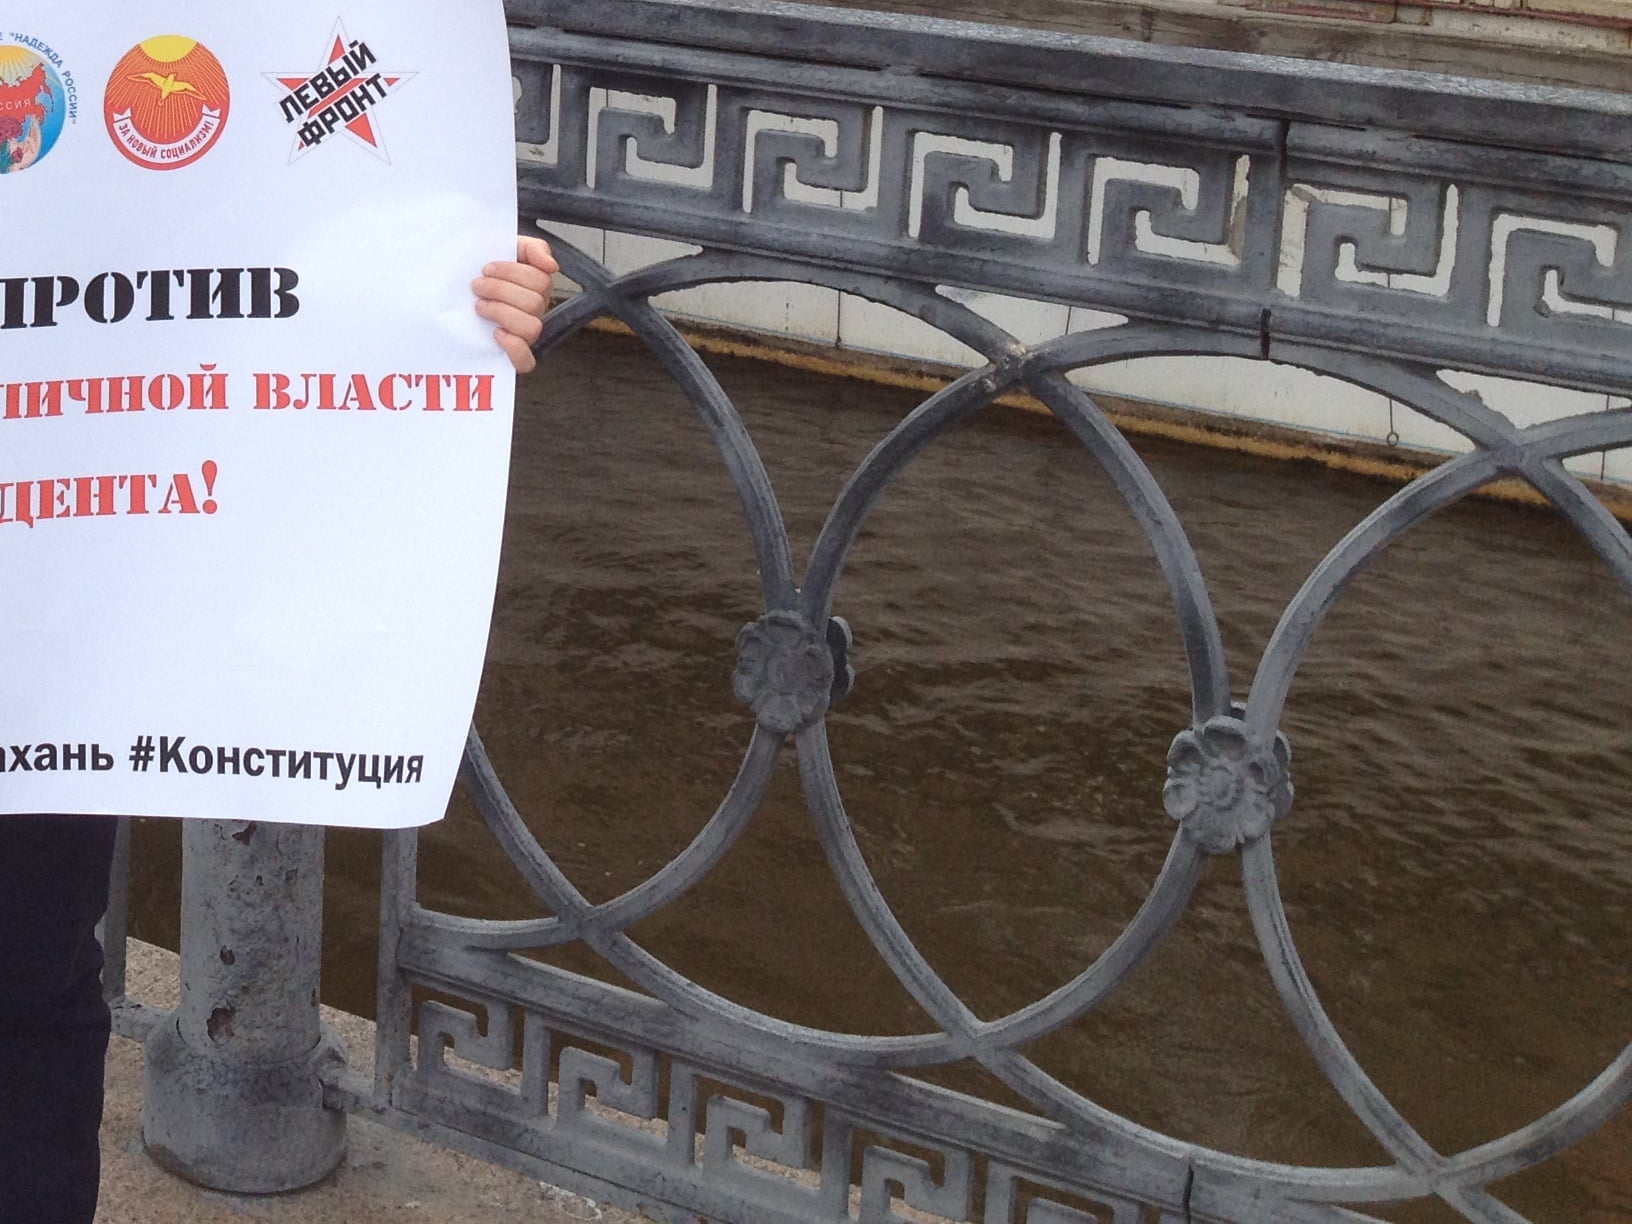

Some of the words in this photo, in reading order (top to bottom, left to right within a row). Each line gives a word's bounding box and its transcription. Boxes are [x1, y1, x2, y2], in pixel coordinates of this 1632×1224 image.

[279, 39, 377, 124] ЛЕВЫЙ
[297, 72, 387, 147] ФРОНТ
[119, 123, 131, 137] ЗА
[126, 136, 157, 159] НОВЫЙ
[252, 371, 496, 413] ВЛАСТИ
[128, 734, 424, 791] #Конституция
